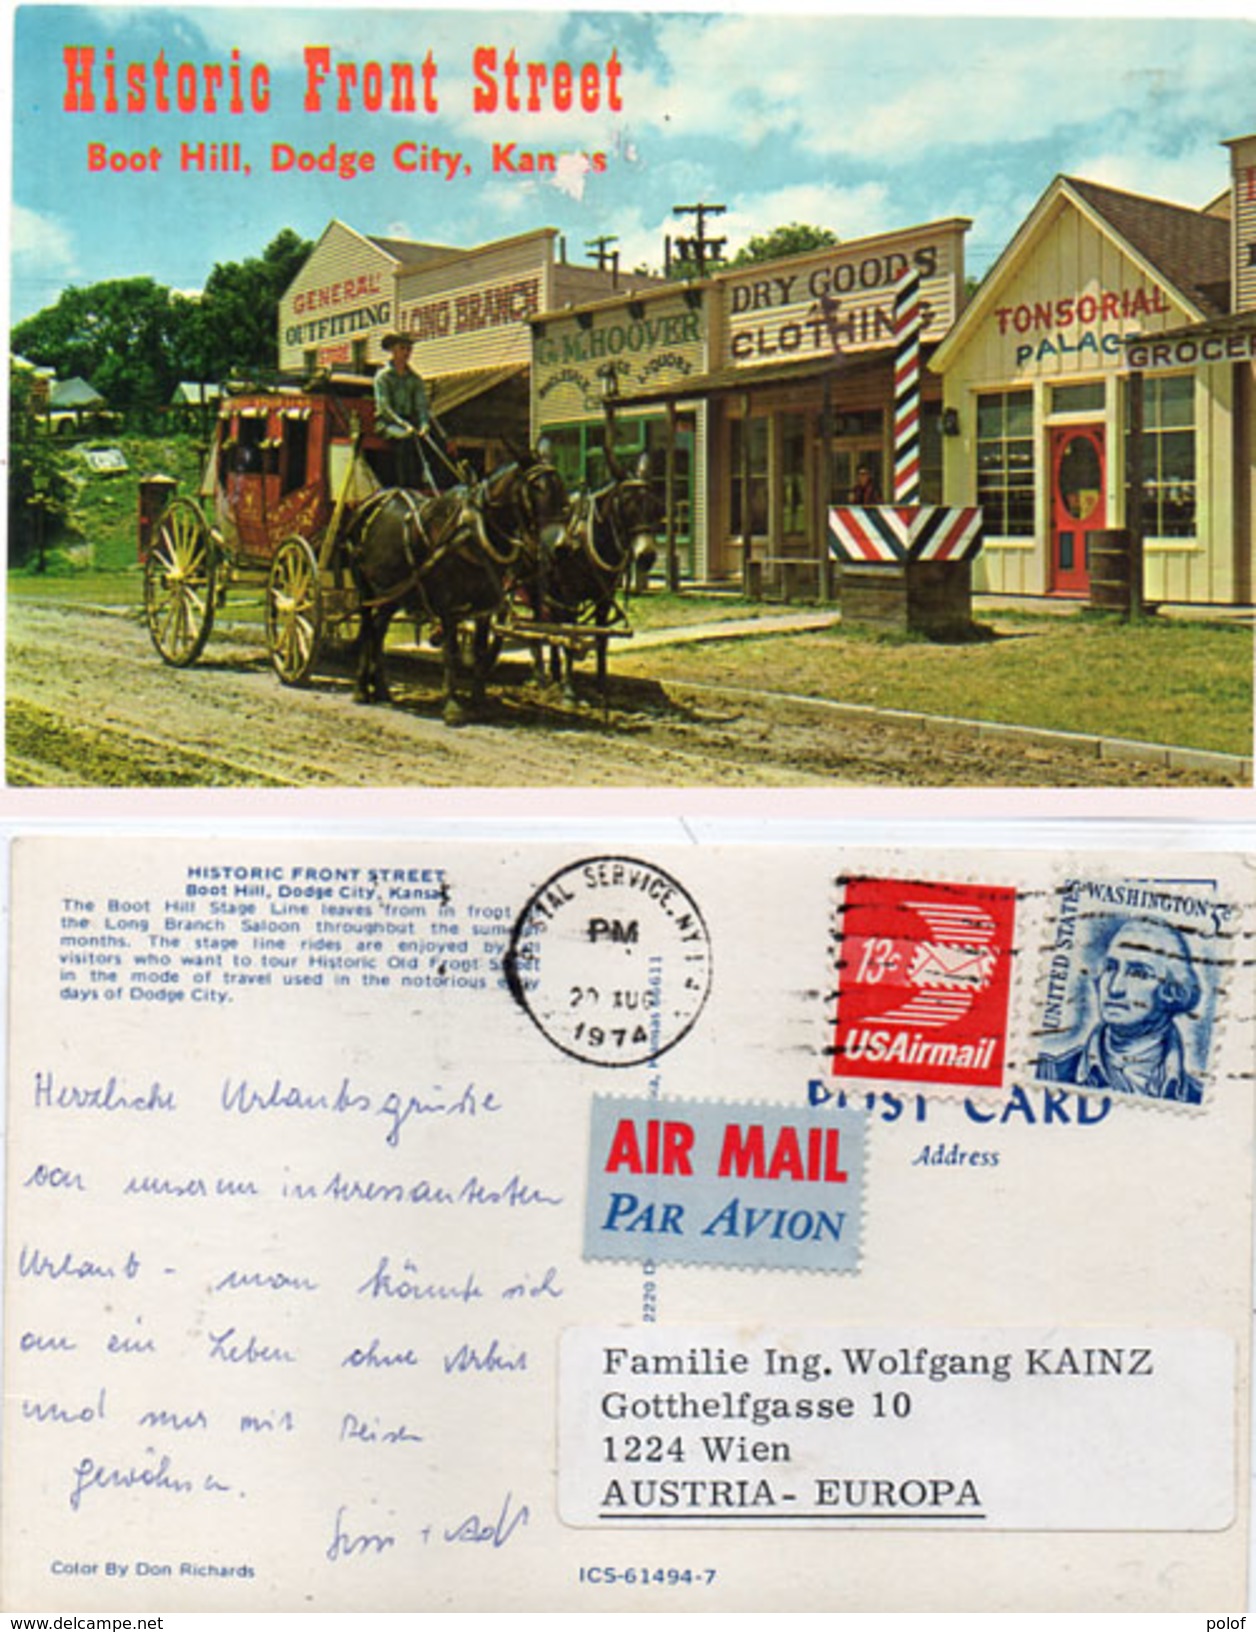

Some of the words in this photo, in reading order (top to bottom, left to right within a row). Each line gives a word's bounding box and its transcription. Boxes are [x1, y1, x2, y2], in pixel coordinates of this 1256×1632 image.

[62, 46, 271, 113] Historic
[303, 46, 438, 113] Front
[473, 46, 623, 113] Street
[87, 143, 162, 173] Boot
[180, 143, 251, 176] Hill,
[271, 143, 375, 179] Dodge
[393, 143, 471, 180] City,
[492, 141, 607, 174] Kans
[293, 272, 380, 315] GENERAL
[731, 276, 798, 314] DRY
[808, 246, 938, 298] GOODS
[286, 301, 391, 346] OUTFITTING
[401, 301, 451, 340] LONG
[455, 278, 539, 334] BRANCH
[995, 285, 1171, 335] TONSORIAL
[590, 311, 704, 360] HOOVER
[1016, 331, 1143, 367] PALAC
[186, 884, 228, 897] Boot
[278, 885, 333, 900] Dodge
[187, 866, 284, 881] HISTORIC
[291, 867, 361, 882] FRONT
[368, 868, 446, 883] STREET
[63, 899, 96, 913] The
[107, 899, 150, 913] Boot
[164, 900, 196, 913] Hill
[209, 901, 256, 917] Stage
[270, 902, 309, 916] Line
[321, 903, 373, 917] leaves
[384, 904, 426, 918] from
[438, 904, 455, 918] in
[468, 904, 512, 919] front
[1055, 879, 1082, 950] STATES
[1085, 881, 1211, 917] WASHINGTON
[60, 934, 131, 948] months.
[148, 934, 181, 947] The
[195, 936, 239, 951] stage
[253, 937, 286, 949] line
[301, 937, 342, 951] rides
[356, 940, 383, 952] are
[398, 940, 469, 954] enjoyed
[484, 940, 506, 954] by
[61, 916, 90, 929] the
[104, 917, 149, 933] Long
[164, 917, 225, 931] Branch
[240, 918, 301, 933] Saloon
[316, 921, 415, 935] throughout
[431, 922, 459, 935] the
[472, 923, 541, 937] sumer
[587, 918, 639, 944] PM
[60, 951, 122, 966] visitors
[133, 952, 172, 966] who
[181, 953, 222, 967] want
[233, 954, 252, 967] to
[261, 955, 298, 968] tour
[308, 955, 377, 970] Historic
[387, 956, 419, 970] Old
[428, 956, 479, 972] Front
[60, 968, 77, 981] in
[90, 969, 118, 983] the
[130, 970, 180, 984] mode
[193, 970, 213, 984] of
[222, 971, 272, 986] travel
[283, 973, 323, 986] used
[334, 974, 351, 986] in
[361, 974, 391, 987] the
[401, 975, 487, 989] notorious
[60, 986, 99, 1002] days
[104, 987, 123, 1001] of
[129, 987, 185, 1004] Dodge
[190, 987, 234, 1004] City.
[1042, 954, 1071, 1029] UNITED
[573, 1021, 648, 1048] 1974
[34, 1072, 178, 1113] Herzliche
[604, 1118, 695, 1177] AIR
[717, 1123, 848, 1184] MAIL
[911, 1143, 1000, 1167] Address
[23, 1164, 86, 1192] von
[282, 1165, 565, 1207] interessantesten
[18, 1244, 141, 1280] Urlaub
[215, 1270, 321, 1291] man
[357, 1255, 484, 1302] könnte
[501, 1266, 564, 1299] sich
[643, 1281, 657, 1323] 2220
[19, 1331, 77, 1352] an
[106, 1315, 156, 1352] ein
[207, 1327, 298, 1363] Leben
[341, 1338, 420, 1368] ohne
[444, 1339, 527, 1374] Arbeit
[602, 1348, 749, 1376] Familie
[764, 1348, 833, 1381] Ing.
[842, 1348, 1011, 1381] Wolfgang
[1024, 1348, 1154, 1377] KAINZ
[22, 1386, 106, 1423] und
[138, 1410, 207, 1431] nur
[239, 1409, 294, 1432] mit
[600, 1392, 855, 1424] Gotthelfgasse
[871, 1392, 912, 1419] 10
[602, 1437, 686, 1464] 1224
[702, 1437, 791, 1464] Wien
[814, 1479, 984, 1508] EUROPA
[50, 1560, 99, 1576] Color
[105, 1561, 128, 1577] By
[135, 1562, 172, 1577] Don
[180, 1562, 256, 1579] Richards
[578, 1566, 718, 1587] ICS-61494-7
